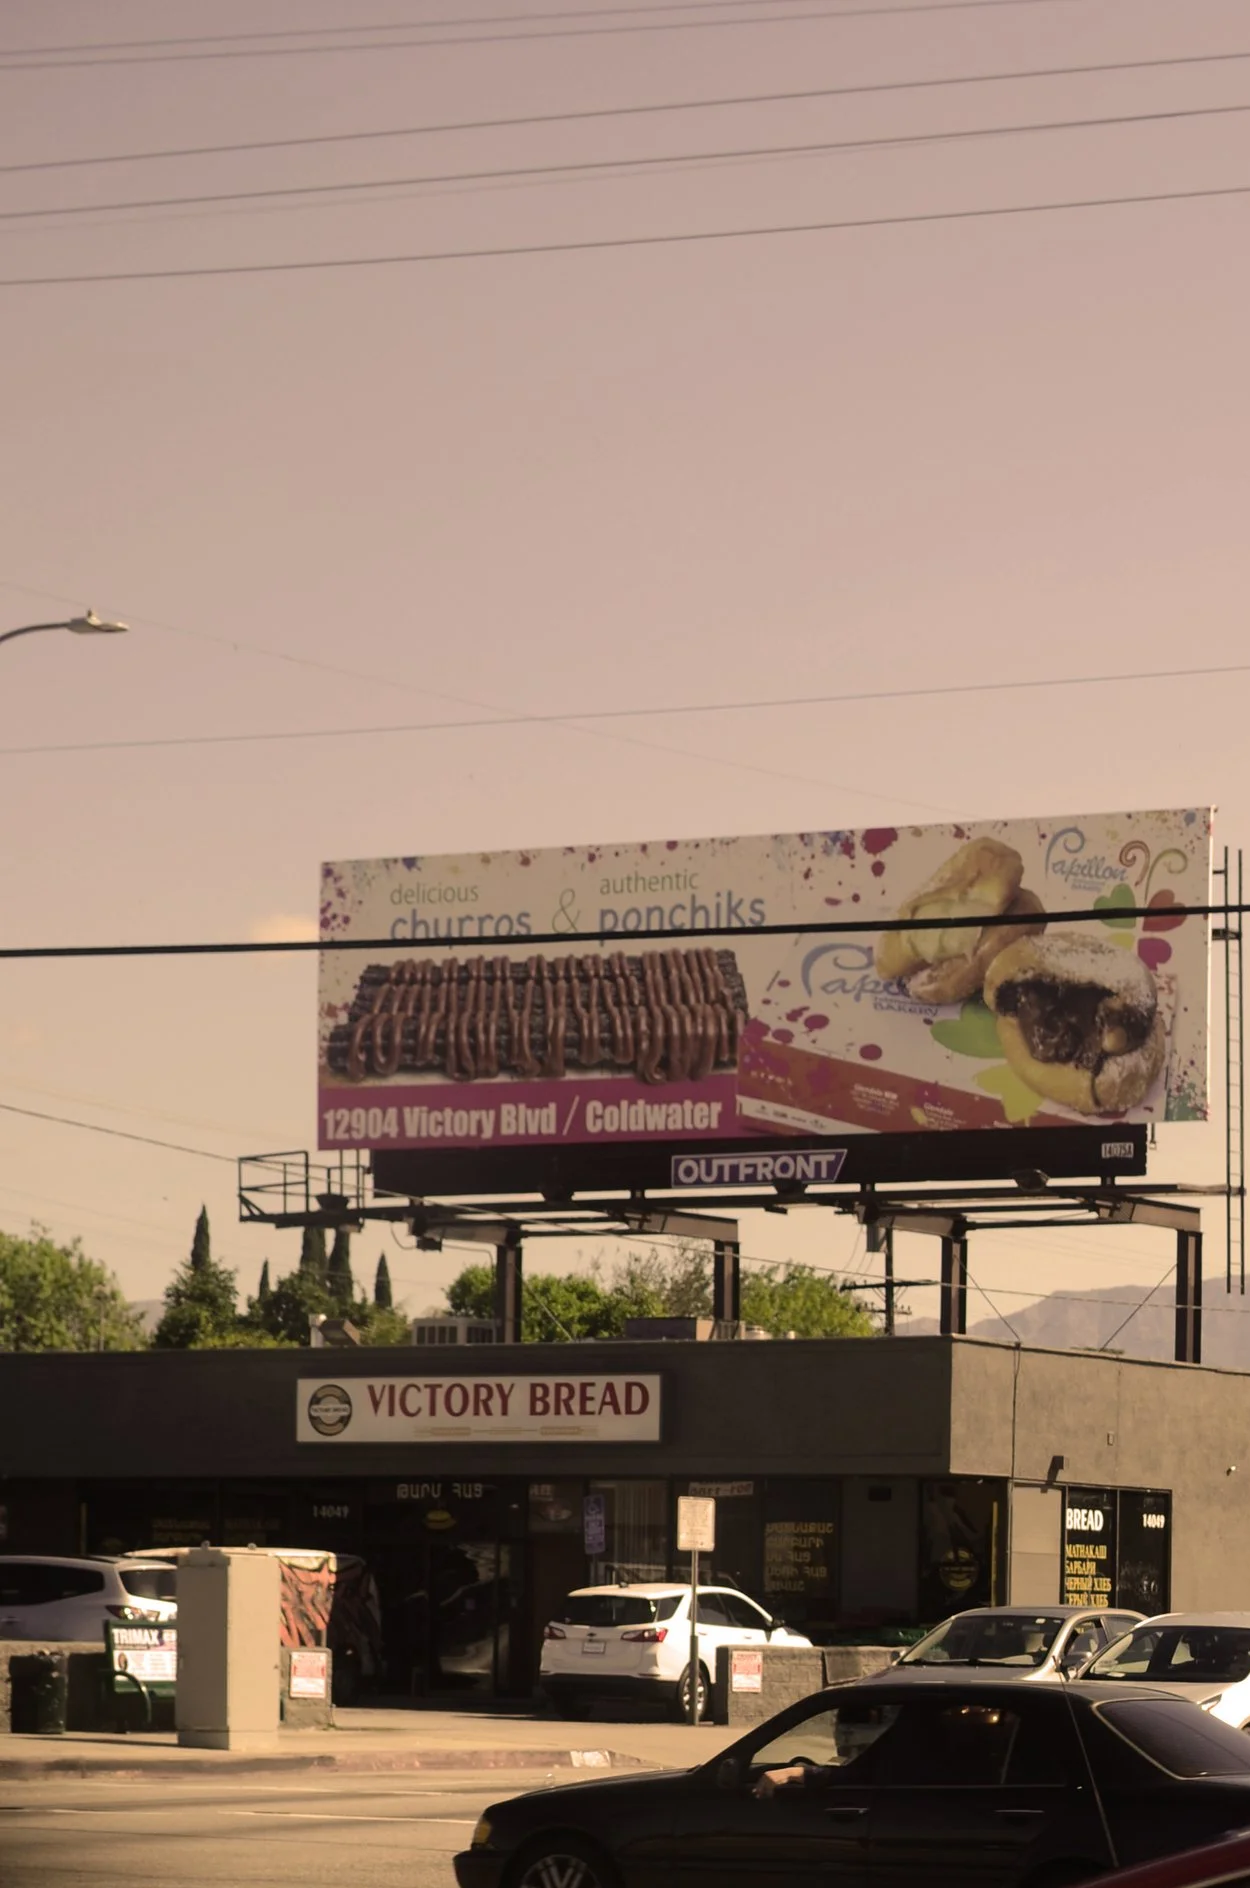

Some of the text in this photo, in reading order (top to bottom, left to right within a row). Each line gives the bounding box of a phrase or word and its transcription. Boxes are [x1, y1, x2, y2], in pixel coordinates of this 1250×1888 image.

[390, 882, 479, 905] delicious
[600, 868, 699, 895] authentic
[390, 888, 766, 947] churros & ponchiks
[323, 1106, 399, 1140] 12904
[403, 1105, 496, 1139] Victory
[500, 1102, 558, 1136] Blvd
[562, 1095, 580, 1136] /
[585, 1099, 723, 1133] Coldwater
[677, 1154, 836, 1184] OUTFRONT
[367, 1382, 650, 1418] VICTORY BREAD
[1066, 1508, 1104, 1531] BREAD
[1142, 1513, 1166, 1529] 14049
[112, 1628, 160, 1645] TRIMAX
